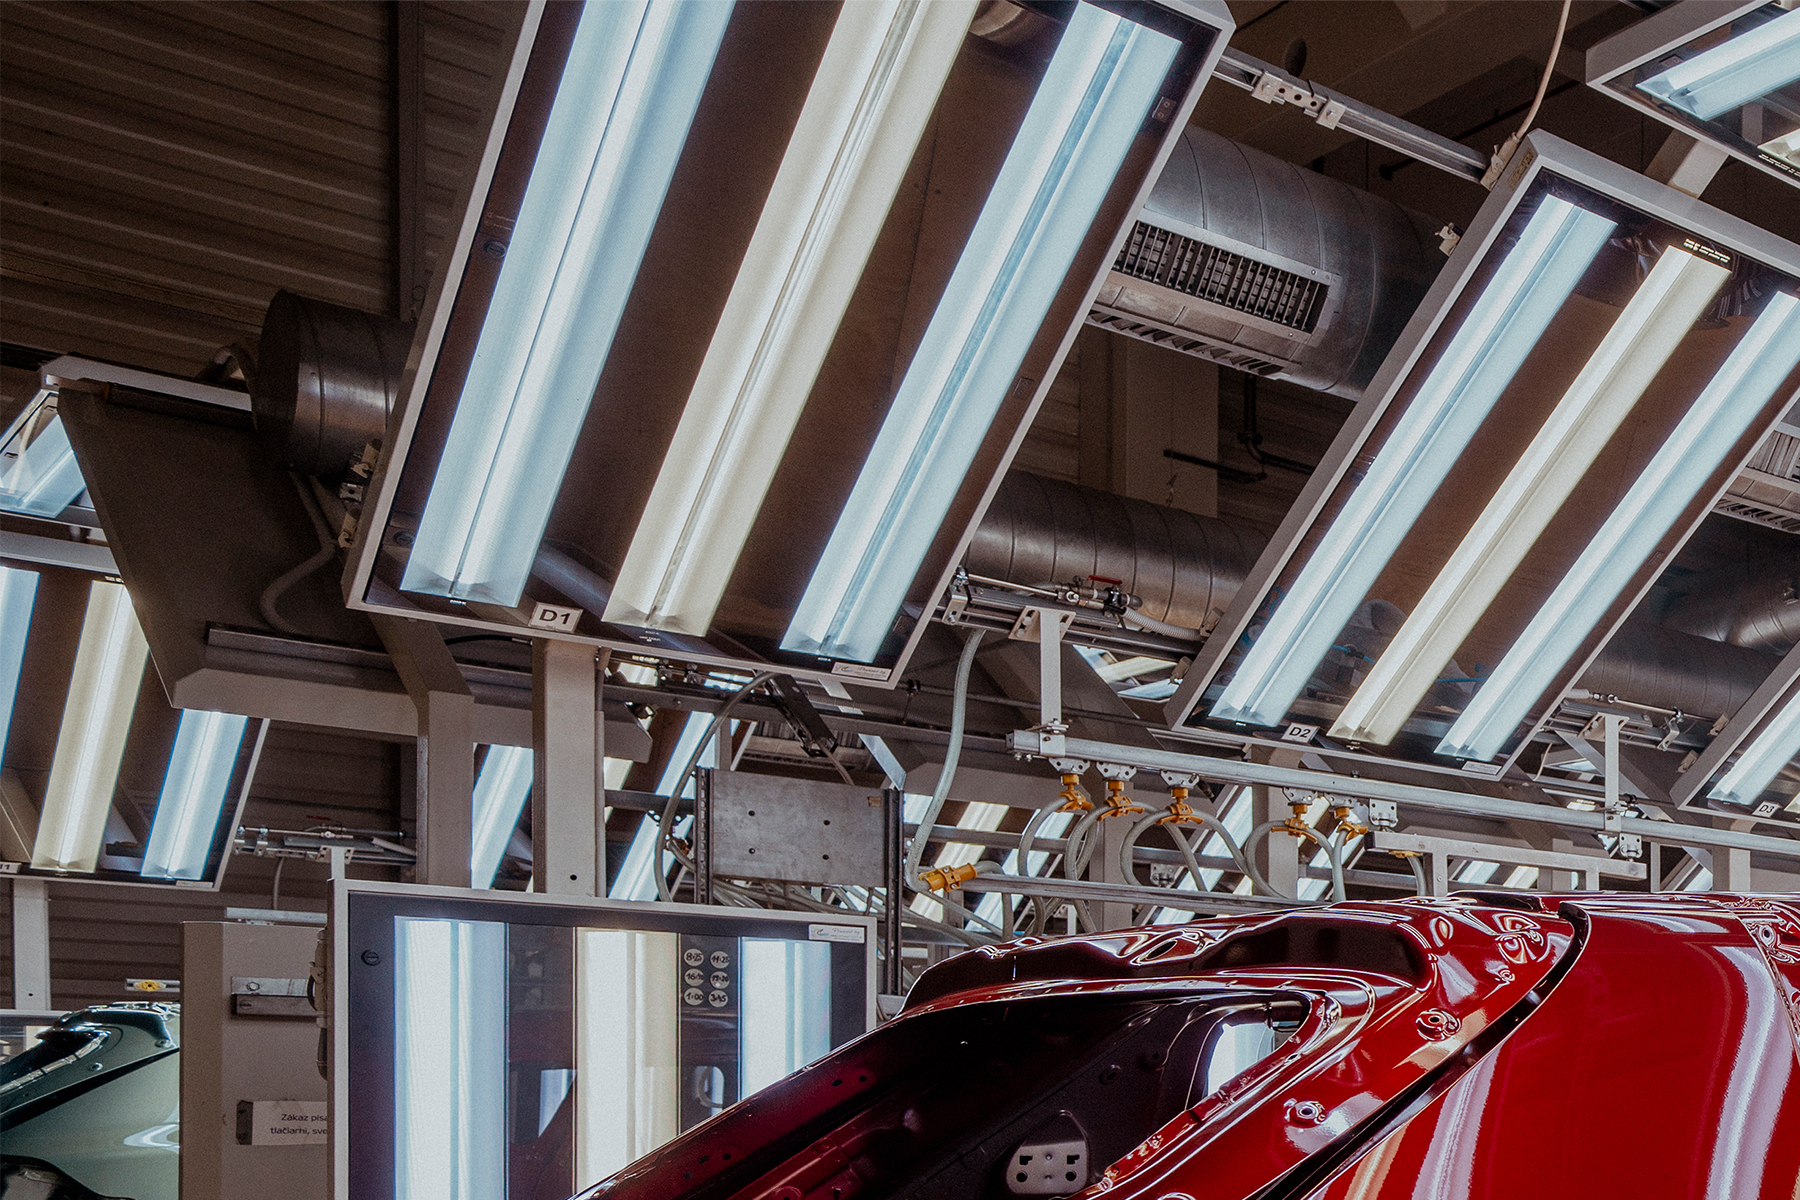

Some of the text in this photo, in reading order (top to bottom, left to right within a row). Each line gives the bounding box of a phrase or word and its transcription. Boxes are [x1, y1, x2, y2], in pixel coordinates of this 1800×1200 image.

[539, 608, 571, 625] D1
[1289, 726, 1311, 738] D2
[1759, 804, 1775, 813] D3
